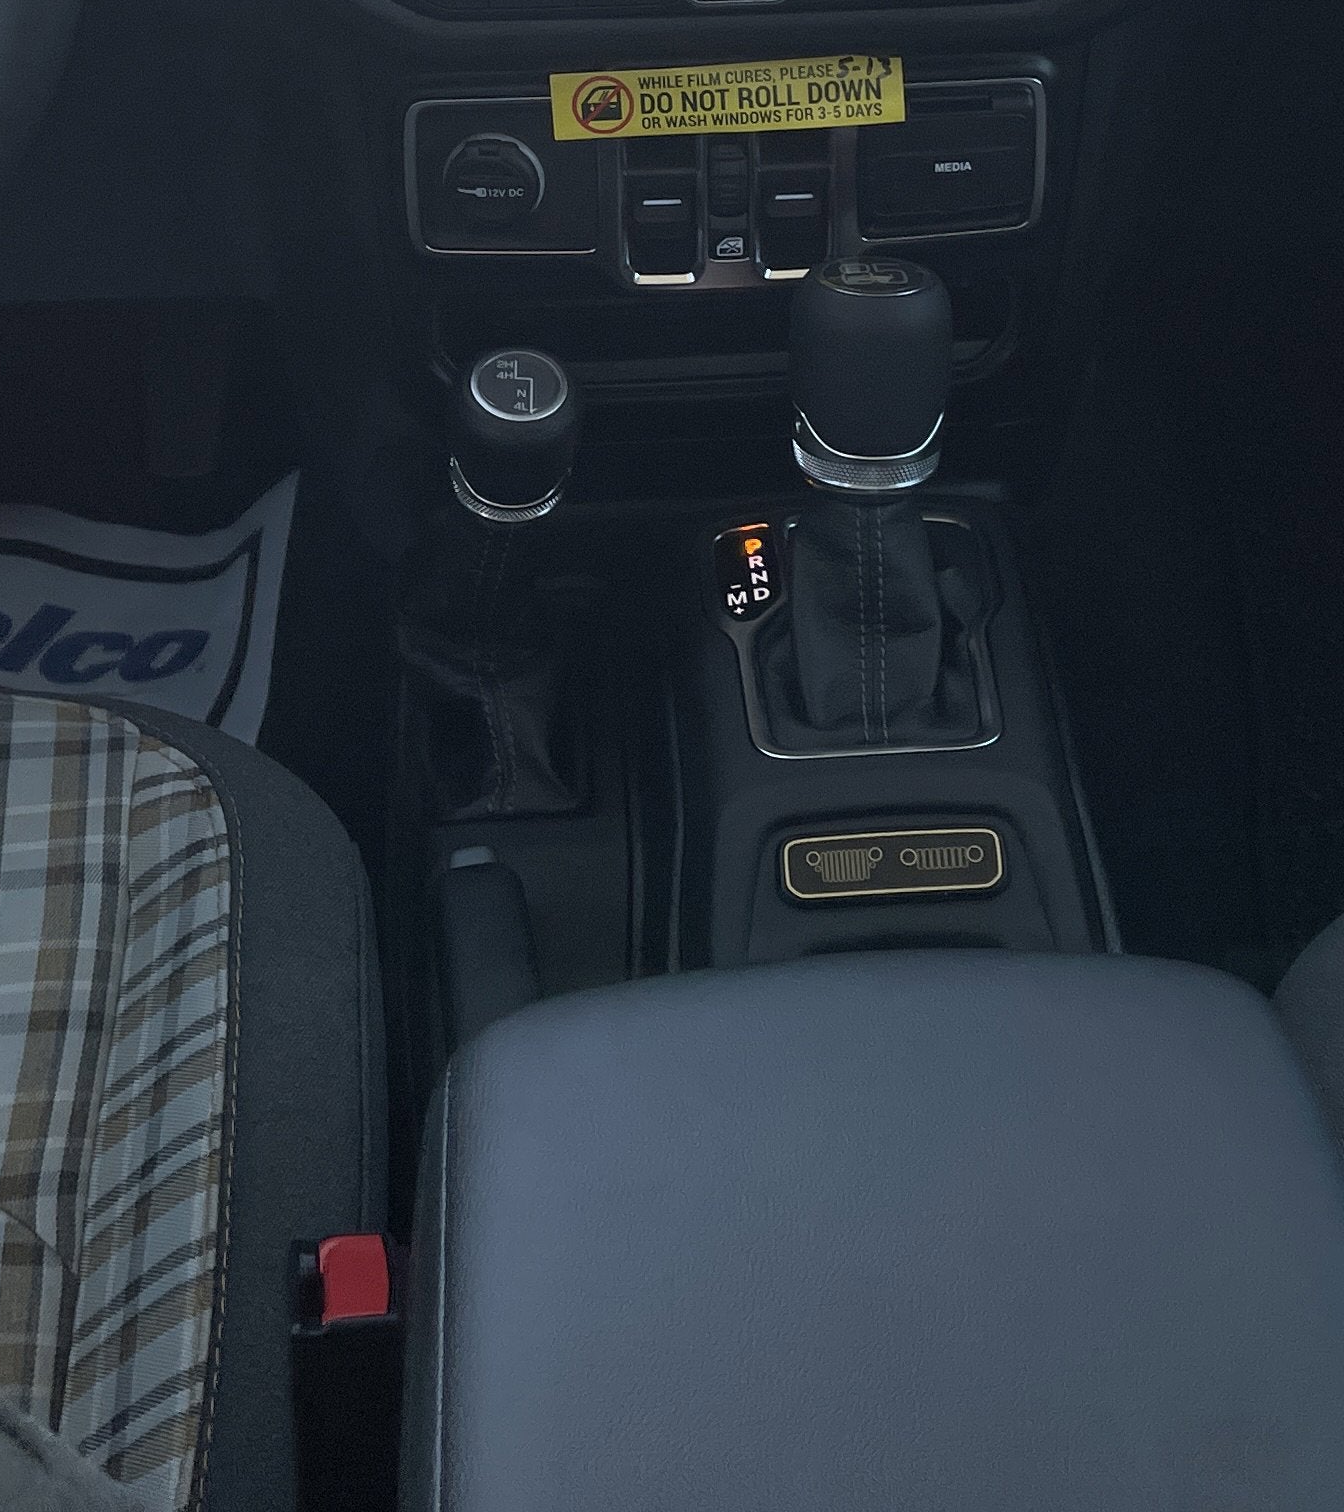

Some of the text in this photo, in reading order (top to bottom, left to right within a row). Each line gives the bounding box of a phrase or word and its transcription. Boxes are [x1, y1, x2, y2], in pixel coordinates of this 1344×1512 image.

[638, 65, 833, 89] WHILE FILM CURES, PLEASE
[641, 79, 882, 114] DO NOT ROLL DOWN
[642, 104, 882, 129] OR WASH WINDOWS FOR 3-5 DAYS
[934, 162, 971, 172] MEDIA
[488, 187, 524, 197] 12V DC
[514, 403, 529, 411] 4L
[744, 539, 761, 554] P
[749, 556, 763, 568] R
[752, 571, 767, 584] N
[728, 590, 747, 607] M
[754, 588, 769, 601] D
